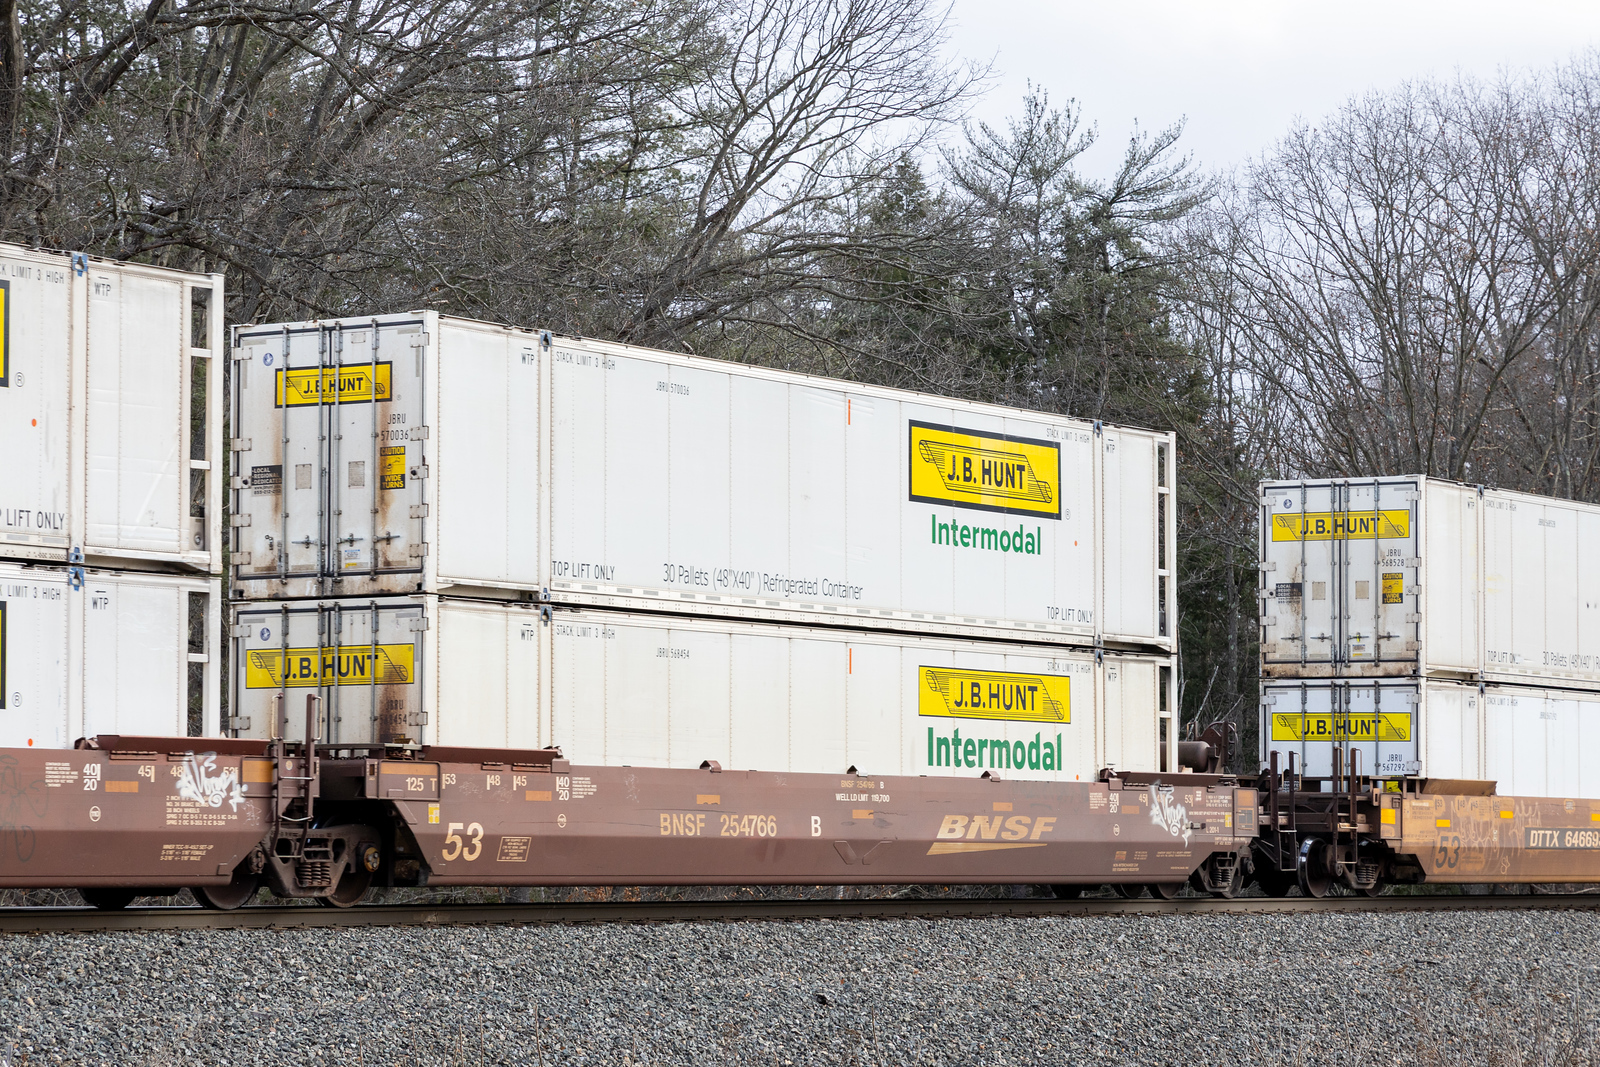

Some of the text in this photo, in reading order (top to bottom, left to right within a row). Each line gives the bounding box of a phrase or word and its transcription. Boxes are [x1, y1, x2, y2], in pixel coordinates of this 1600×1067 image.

[12, 264, 31, 279] LIMIT
[37, 268, 41, 280] 3
[46, 270, 64, 284] HIGH
[94, 282, 112, 296] WTP
[521, 353, 534, 366] WTP
[556, 351, 615, 370] STACK LIMIT 3 HIGH
[671, 383, 689, 395] 570036
[387, 413, 406, 424] JBRU
[380, 430, 408, 441] 570036
[381, 446, 404, 455] CAUTION
[1106, 444, 1115, 453] WTP
[7, 508, 64, 530] LIFT ONLY
[932, 514, 1041, 555] Intermodal
[552, 561, 615, 581] TOP LIFT ONLY
[663, 564, 675, 582] 30
[678, 565, 709, 586] Pallets
[764, 574, 818, 597] Refrigerated
[822, 578, 863, 600] Container
[8, 585, 28, 598] LIMIT
[33, 587, 37, 598] 3
[42, 588, 60, 600] HIGH
[92, 597, 109, 610] WTP
[1047, 606, 1093, 623] TOP LIFT ONLY
[521, 630, 534, 641] WTP
[556, 625, 574, 636] STACK
[595, 628, 599, 638] 3
[602, 628, 615, 639] HIGH
[1108, 673, 1117, 682] WTP
[928, 727, 1062, 771] Intermodal
[1387, 754, 1402, 762] JBRU
[83, 764, 97, 776] 40
[138, 766, 151, 778] 45
[406, 777, 424, 792] 125
[445, 773, 456, 784] 53
[489, 775, 500, 786] 48
[516, 775, 527, 786] 45
[559, 776, 570, 788] 40
[841, 780, 854, 788] BNSF
[84, 779, 97, 791] 20
[559, 790, 570, 801] 20
[1184, 795, 1191, 804] 53
[1110, 804, 1118, 813] 20
[660, 813, 821, 837] BNSF 254766 B
[936, 815, 1057, 840] BNSF
[442, 822, 484, 861] 53
[1530, 830, 1600, 848] DTTX 64669
[1436, 836, 1460, 868] 53
